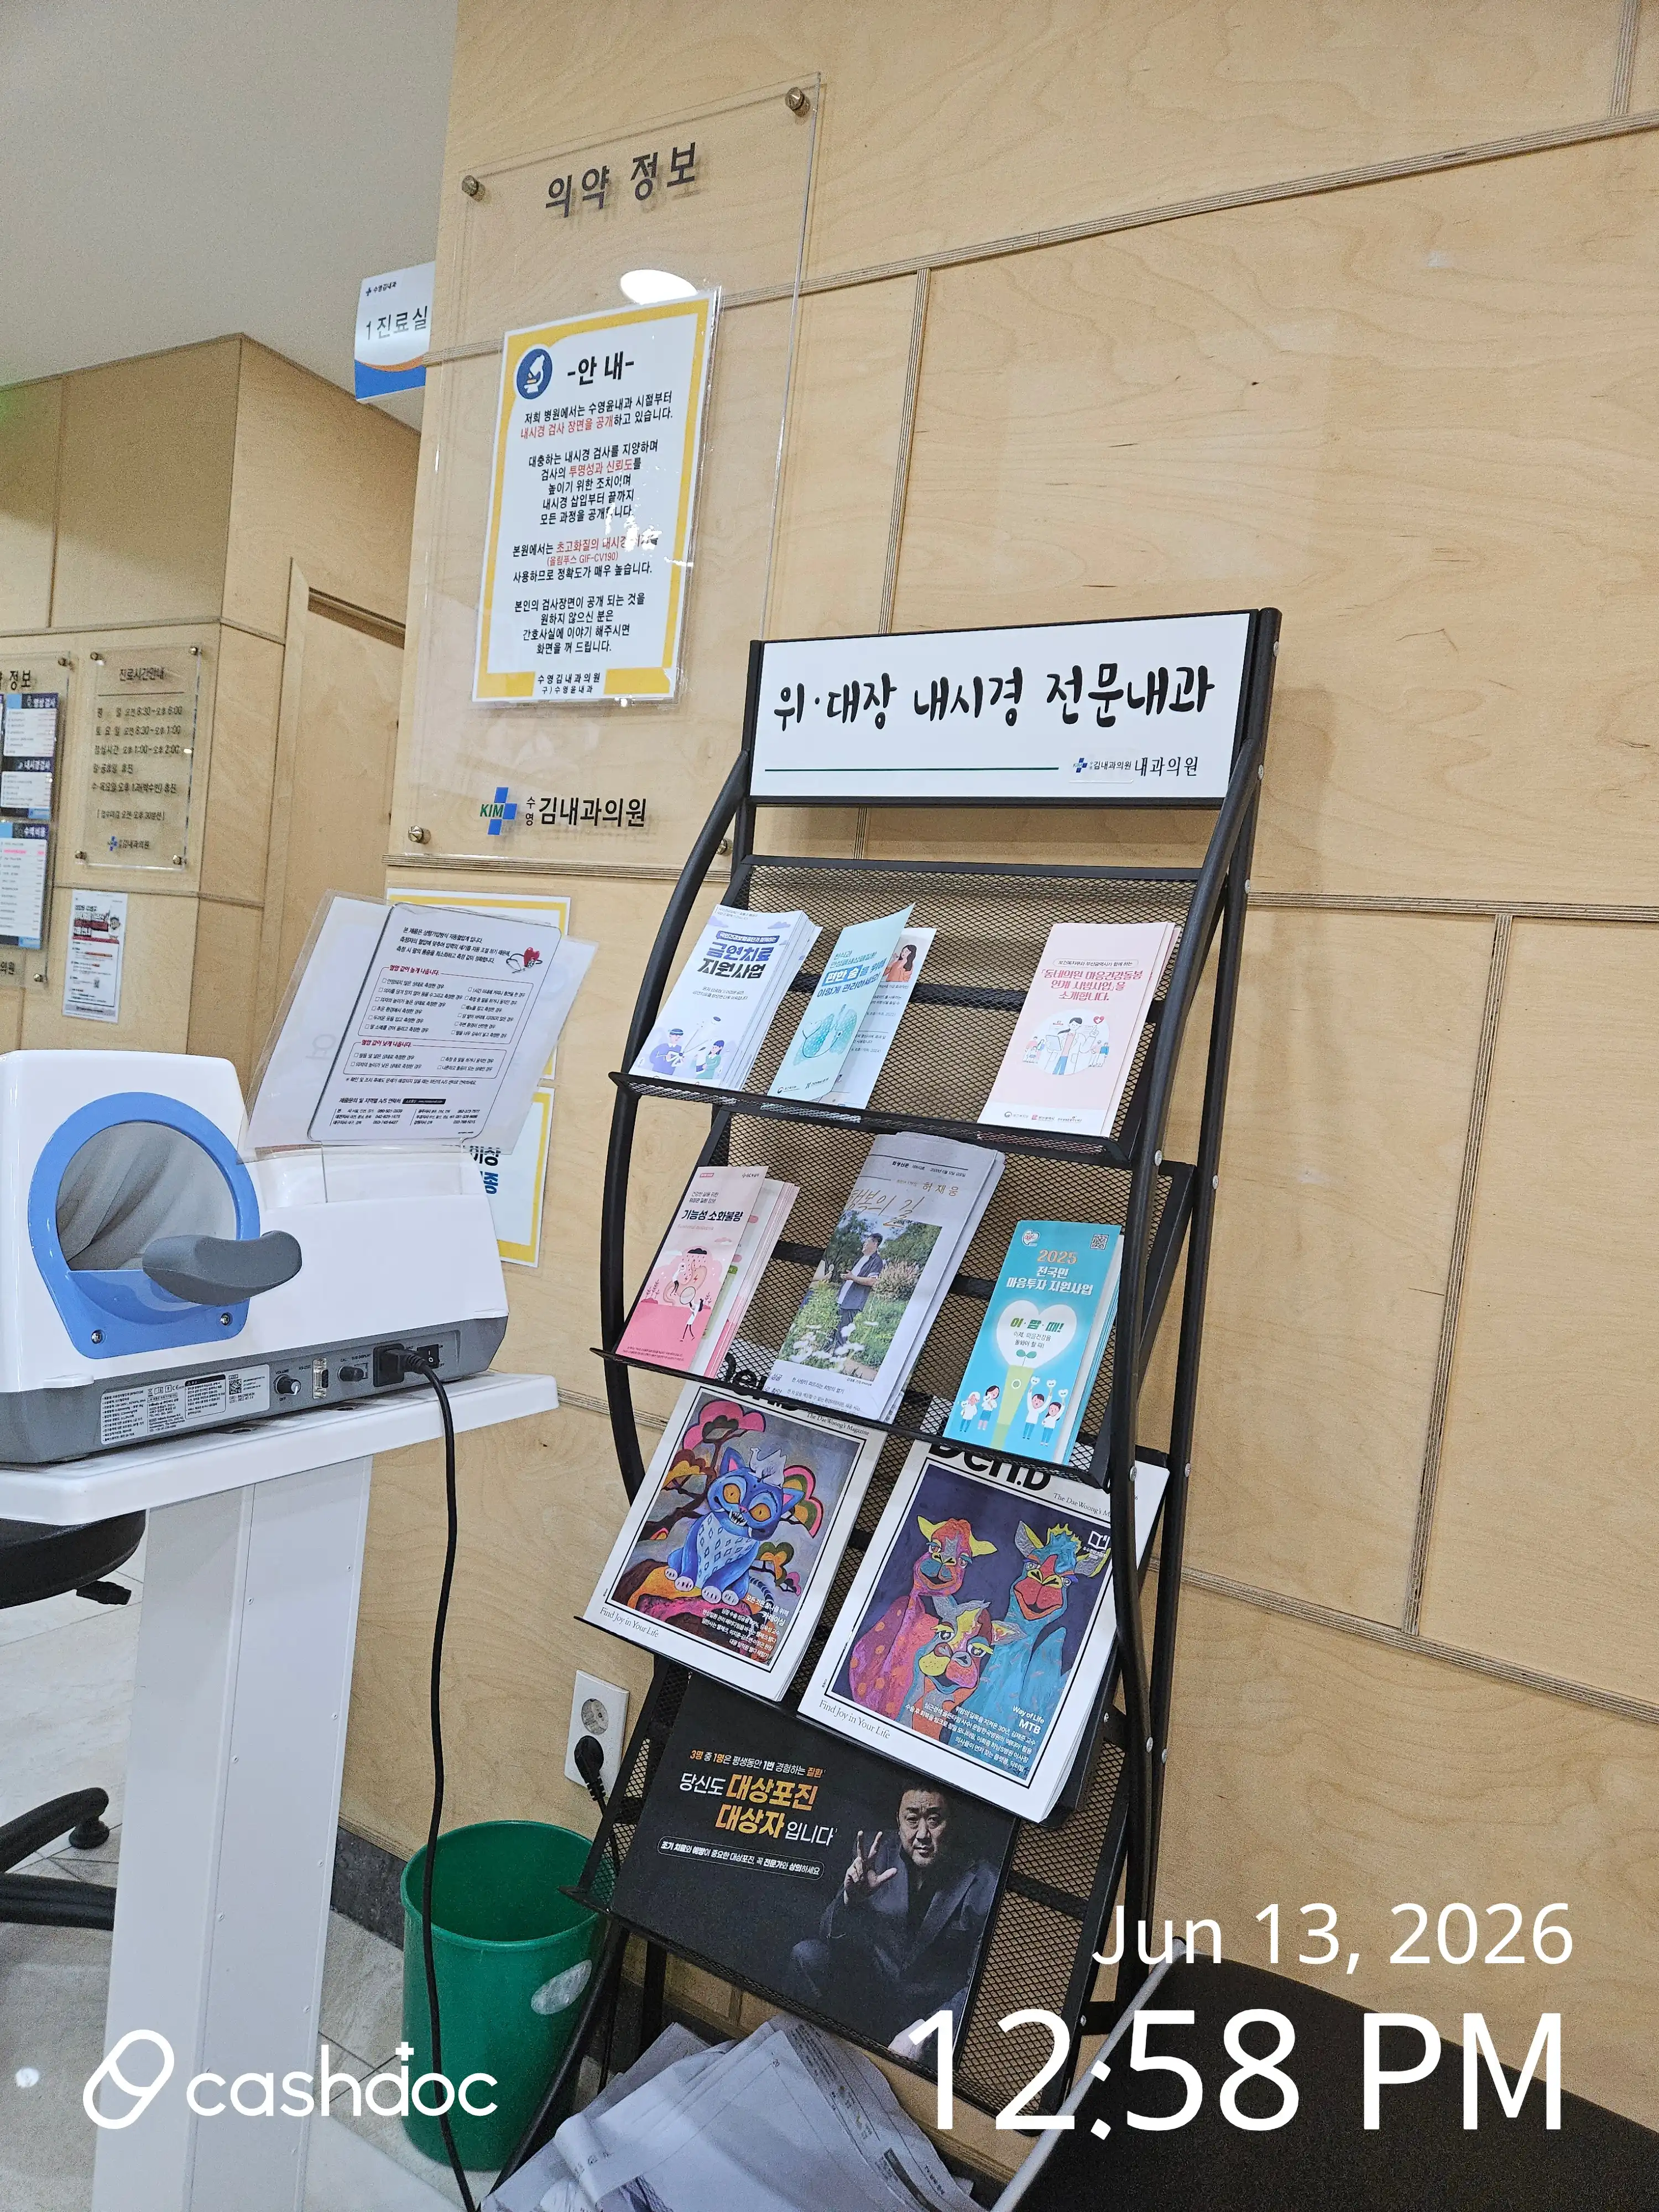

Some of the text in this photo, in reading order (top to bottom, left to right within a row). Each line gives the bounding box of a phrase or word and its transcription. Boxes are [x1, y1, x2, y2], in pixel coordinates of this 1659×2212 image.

[545, 142, 697, 218] 의약 정보
[524, 390, 672, 424] 저희 병원에서는 수영윤내과 시절부터
[520, 406, 673, 440] 내시경 검사 장면을 공개하고 있습니다.
[529, 439, 658, 468] 대충하는 내시경 검사를 지양하며
[541, 457, 641, 482] 검사의 투명성과 신뢰도를
[548, 473, 631, 495] 높이기 위한 조치이며
[543, 488, 634, 511] 내시경 삽입부터 끝까지
[540, 508, 585, 525] 모든 과정을
[513, 537, 599, 557] 본원에서는 초고화질의
[513, 561, 653, 583] 사용하므로 정확도가 매우 높습니다.
[514, 592, 645, 613] 본인의 검사장면이 공개 되는 것을
[540, 609, 614, 626] 원하지 않으신 분은
[523, 624, 630, 641] 간호사실에 이야기 해주시면
[536, 640, 612, 655] 화면을 꺼 드립니다.
[914, 666, 1024, 727] 내시경
[1047, 662, 1214, 727] 전문내과
[1094, 761, 1131, 770] 김내과의원
[1135, 757, 1198, 776] 내과의원
[479, 804, 504, 818] KIM
[539, 797, 646, 827] 김내과의원
[706, 941, 774, 962] 금연치료
[697, 958, 766, 979] 지원사업
[681, 1209, 743, 1222] 기능성 소화불량
[1037, 1249, 1078, 1264] 2025
[1036, 1266, 1070, 1279] 전국민
[1006, 1277, 1094, 1296] 마음투자 지원사업
[807, 1412, 818, 1421] The
[846, 1423, 870, 1436] Magazine
[1053, 1493, 1065, 1501] The
[600, 1607, 659, 1637] Find Joy in Your Life
[761, 1612, 786, 1626] 카레이싱
[780, 1606, 790, 1617] 위해
[819, 1700, 890, 1739] Find Joy in Your Life
[1012, 1705, 1027, 1718] Way
[1032, 1713, 1045, 1724] Life
[1018, 1719, 1041, 1735] MTB
[956, 1736, 974, 1749] 의사들이
[690, 1750, 703, 1760] 3명
[704, 1752, 712, 1761] 중
[713, 1753, 731, 1765] 1명은
[732, 1755, 762, 1769] 평생동안
[763, 1760, 775, 1771] 1번
[775, 1762, 806, 1776] 경험하는
[680, 1773, 818, 1811] 당신도 대상포진
[715, 1804, 785, 1839] 대상자
[661, 1841, 821, 1875] 조기 치료와 예방이 중요한 대상포진, 꼭 전문가와 상의하세요
